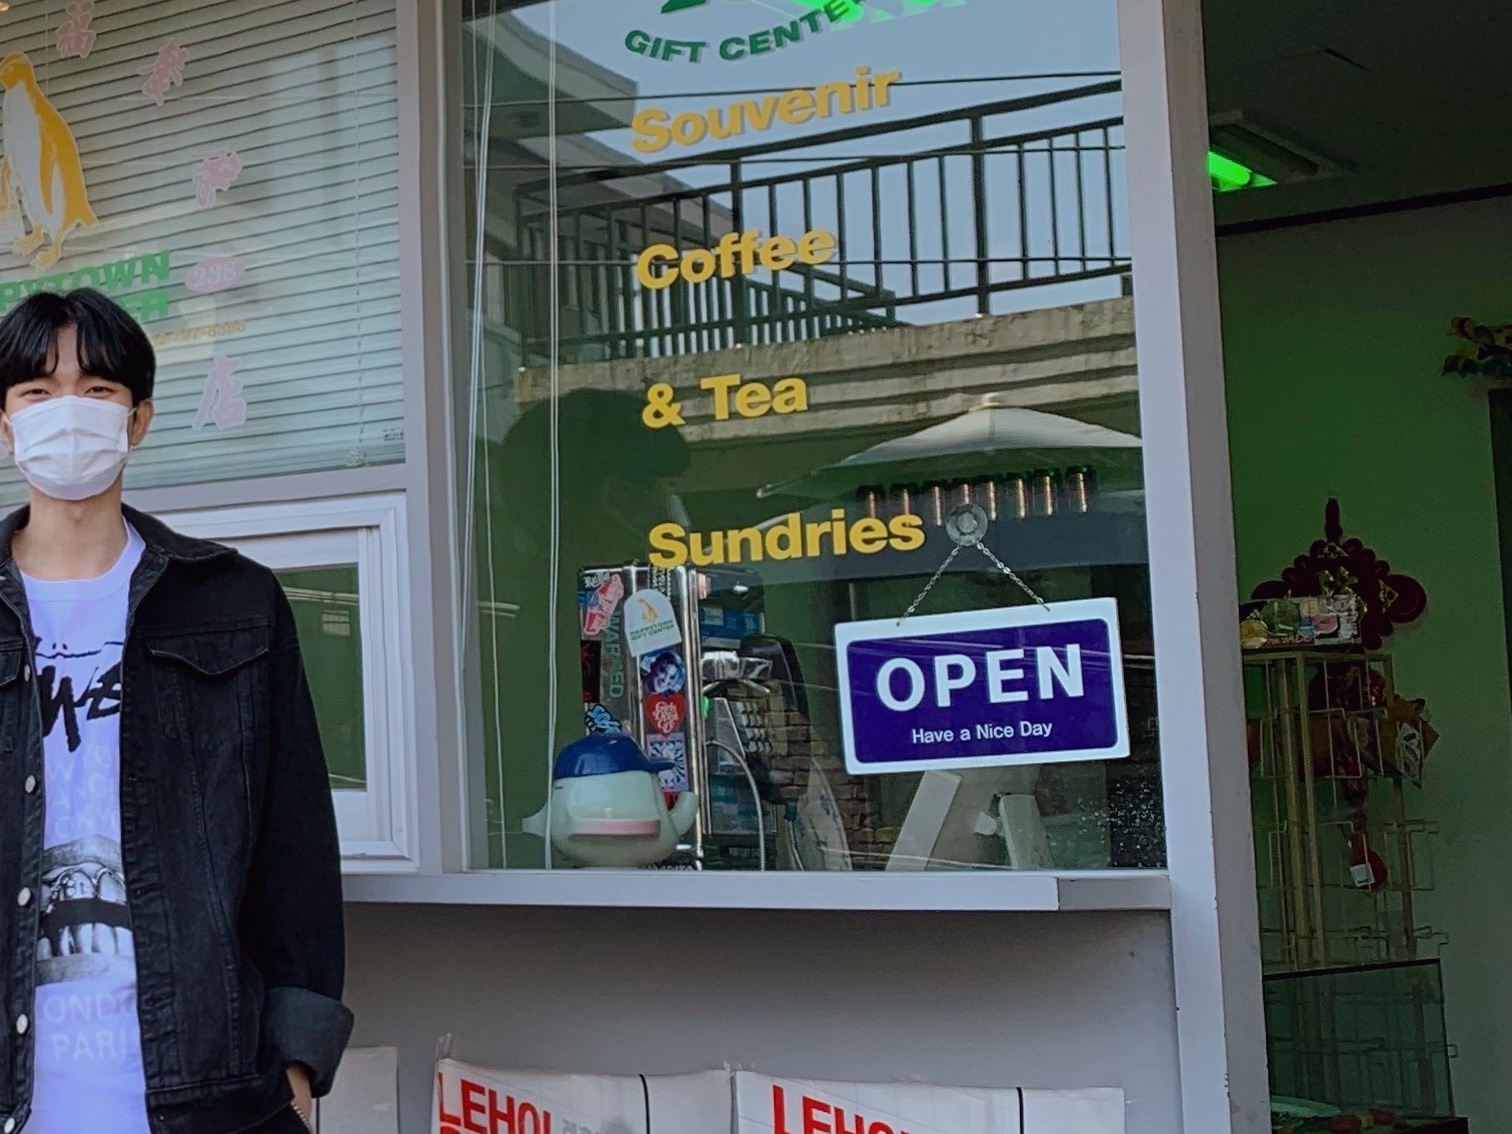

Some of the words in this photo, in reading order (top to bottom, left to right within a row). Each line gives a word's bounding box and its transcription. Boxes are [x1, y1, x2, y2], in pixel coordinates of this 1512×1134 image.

[624, 30, 706, 64] GIFT
[719, 0, 866, 61] CENTE
[631, 66, 902, 154] Souvenir
[637, 228, 836, 290] Coffee
[642, 382, 686, 429] &
[701, 373, 809, 421] Tea
[648, 507, 926, 569] Sundries
[876, 643, 1084, 711] OPEN
[912, 728, 954, 744] Have
[959, 729, 971, 741] a
[976, 724, 1015, 739] Nice
[1020, 720, 1053, 737] Day
[52, 1026, 128, 1062] PARI
